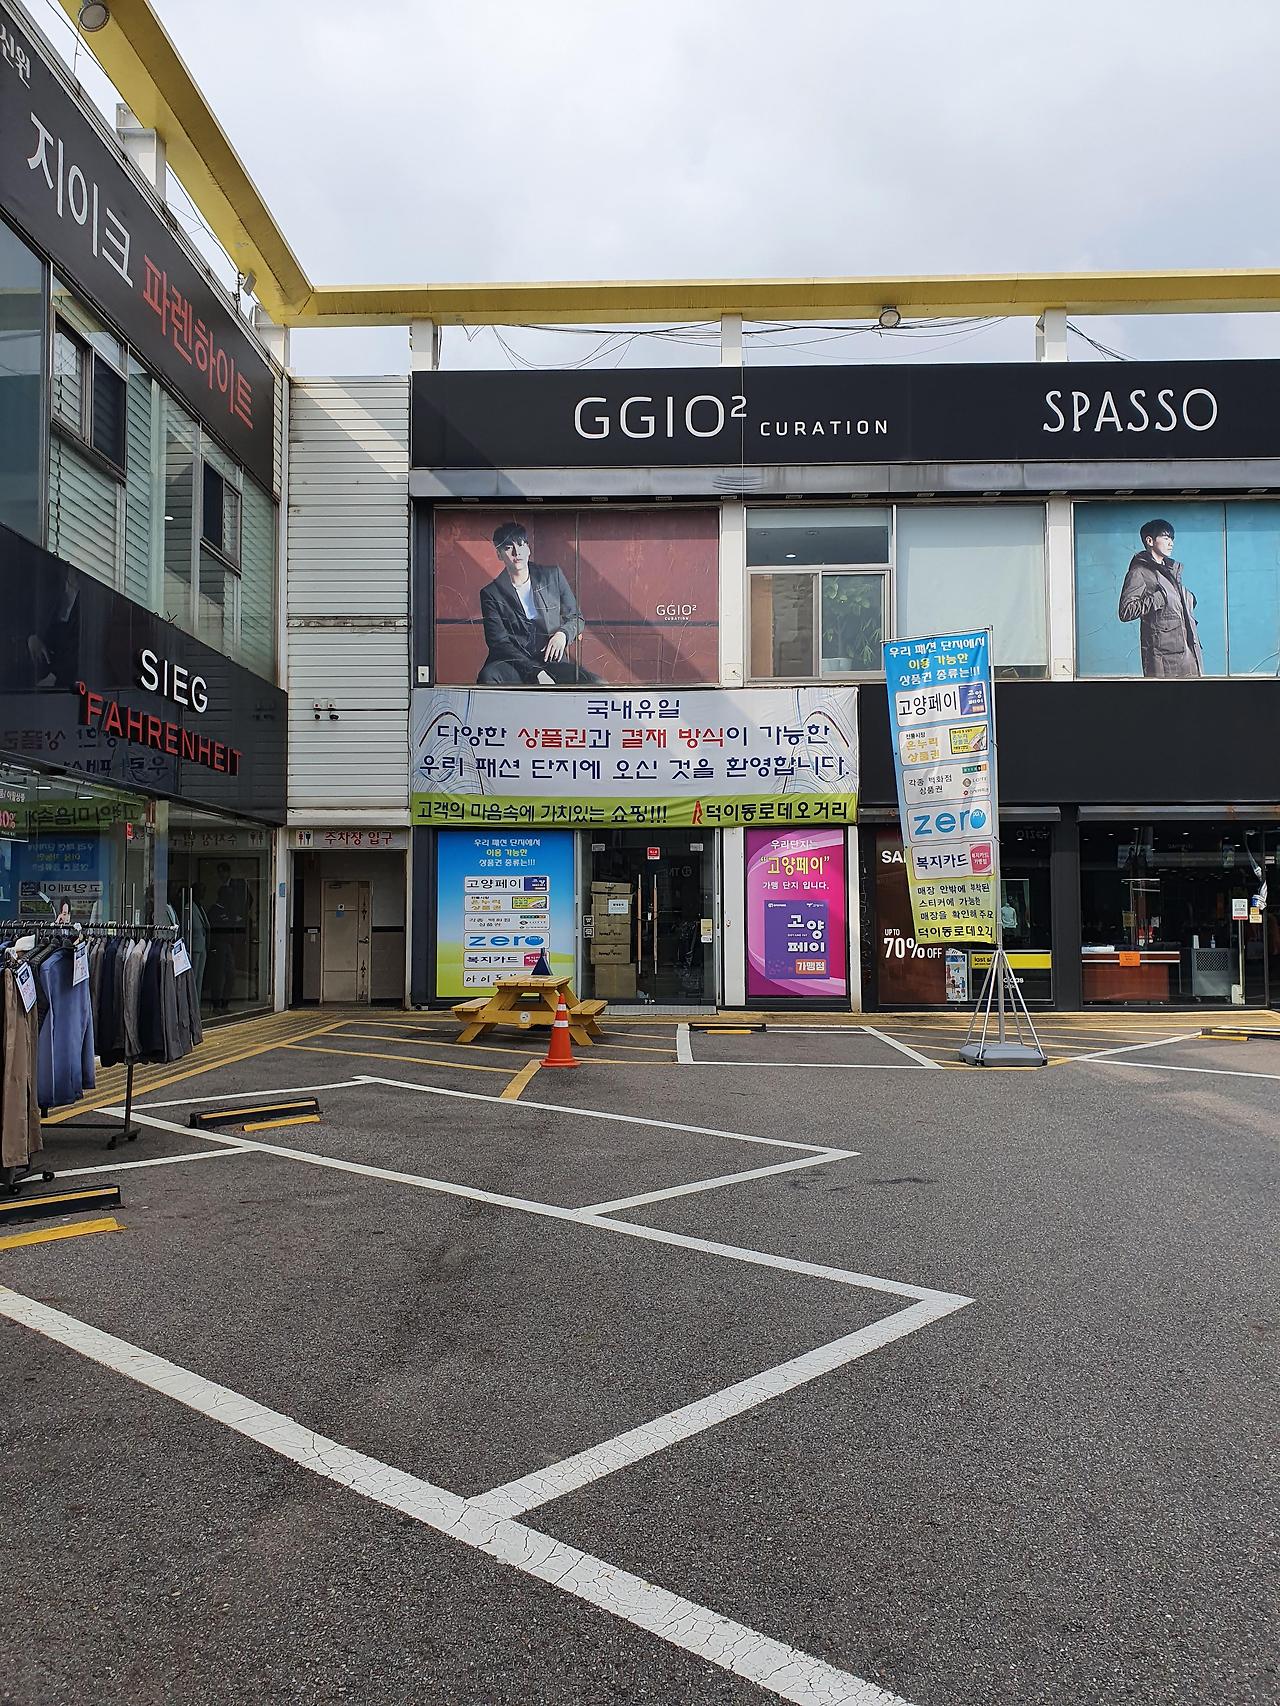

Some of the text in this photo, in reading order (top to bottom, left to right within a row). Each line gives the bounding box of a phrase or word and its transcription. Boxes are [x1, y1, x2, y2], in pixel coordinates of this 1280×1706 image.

[27, 111, 254, 430] 지이크 파렌하이트
[1043, 388, 1218, 432] SPASSO
[760, 419, 888, 437] CURATION
[889, 637, 984, 658] 우리 패션 단지에서
[909, 658, 930, 669] 이용
[141, 649, 208, 713] SIEG
[900, 672, 932, 686] 상품권
[588, 699, 680, 720] 국내유일
[898, 691, 958, 716] 고양페이
[437, 724, 830, 749] 다양한 상품권과 결재 방식이 가능한
[420, 755, 850, 780] 우리 패션 단지에 오신 것을 환영합니다.
[417, 801, 848, 824] 고객의 마음속에 가치있는 쇼핑!!! 덕이동로데오거리
[325, 831, 394, 846] 주차장 입구
[916, 854, 969, 870] 복지카드
[466, 879, 521, 889] 고양페이
[762, 881, 779, 890] 가맹
[783, 881, 799, 890] 단지
[917, 886, 935, 895] 매장
[939, 884, 966, 894] 안밖에
[919, 898, 955, 907] 스티커에
[920, 911, 947, 920] 매장을
[787, 914, 825, 940] 고양
[787, 941, 825, 952] 페이
[883, 938, 943, 959] 70% OFF
[467, 956, 519, 964] 복지카드
[796, 961, 825, 971] 가맹점
